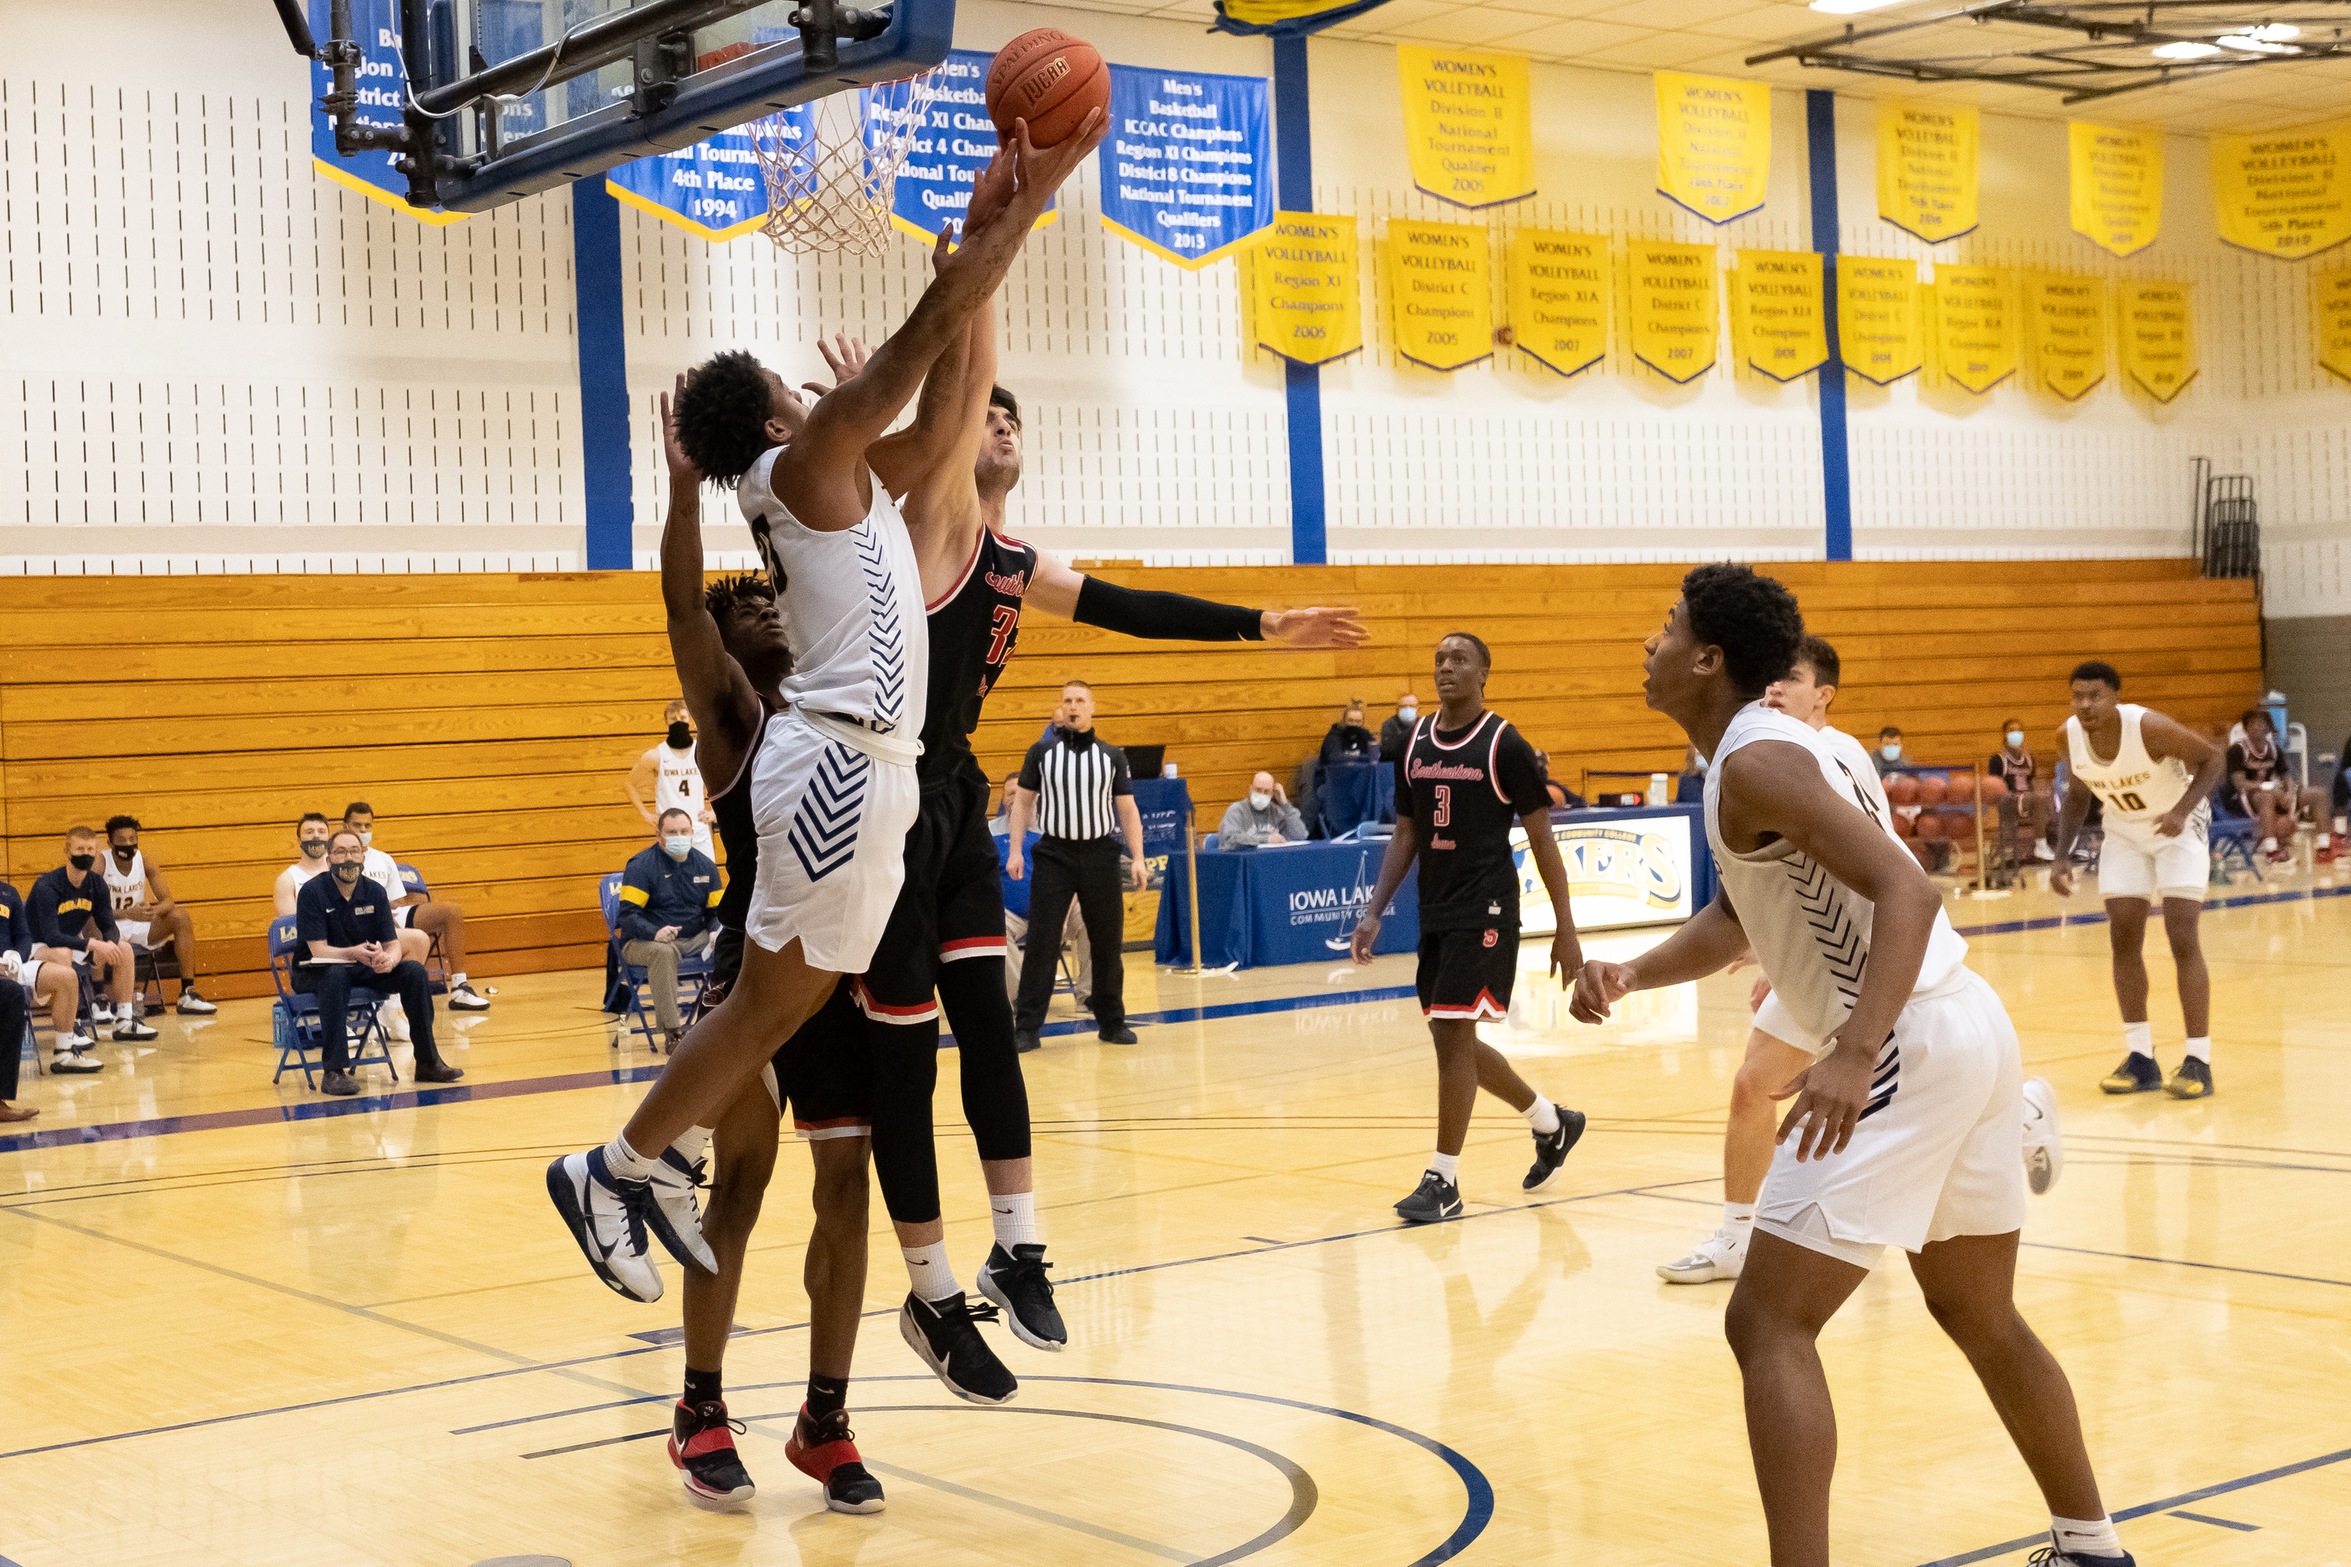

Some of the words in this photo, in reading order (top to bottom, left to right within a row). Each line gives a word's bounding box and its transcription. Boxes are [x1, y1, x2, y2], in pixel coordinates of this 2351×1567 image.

[1431, 59, 1498, 78] WOMEN'S
[1163, 78, 1203, 97] Men's
[1423, 78, 1505, 99] VOLLEYBALL
[1684, 86, 1743, 104] WOMEN'S
[1149, 99, 1218, 119] Basketball
[1430, 100, 1486, 118] Division
[1679, 102, 1750, 124] VOLLEYBALL
[931, 111, 949, 129] XI
[1124, 118, 1169, 137] ICCAC
[1170, 123, 1244, 144] Champions
[1439, 122, 1498, 140] National
[936, 139, 949, 155] 4
[1115, 139, 1162, 160] Region
[1165, 145, 1179, 160] XI
[1181, 146, 1253, 166] Champions
[1428, 137, 1511, 157] Tournament
[672, 169, 703, 188] 4th
[707, 170, 756, 192] Place
[1118, 162, 1166, 181] District
[1168, 167, 1179, 183] 8
[1180, 167, 1252, 188] Champions
[1119, 184, 1175, 204] National
[1177, 189, 1253, 208] Tournament
[693, 198, 738, 219] 1994
[1156, 209, 1222, 228] Qualifiers
[1173, 231, 1207, 250] 2013
[1407, 231, 1469, 248] WOMEN'S
[1532, 240, 1592, 257] WOMEN'S
[1265, 246, 1347, 264] VOLLEYBALL
[1401, 254, 1476, 273] VOLLEYBALL
[1274, 271, 1320, 290] Region
[1327, 275, 1341, 288] XI
[1528, 263, 1600, 281] VOLLEYBALL
[1411, 279, 1455, 295] District
[1530, 287, 1570, 304] Region
[1270, 296, 1344, 315] Champions
[1406, 302, 1474, 321] Champions
[1533, 310, 1598, 328] Champions
[663, 768, 679, 777] IOWA
[678, 779, 690, 797] 4
[1433, 784, 1451, 827] 3
[2107, 792, 2147, 812] 10
[115, 895, 134, 910] 12
[1289, 888, 1339, 912] IOWA
[1341, 884, 1376, 906] LAK
[1290, 909, 1354, 926] COMMUNITY
